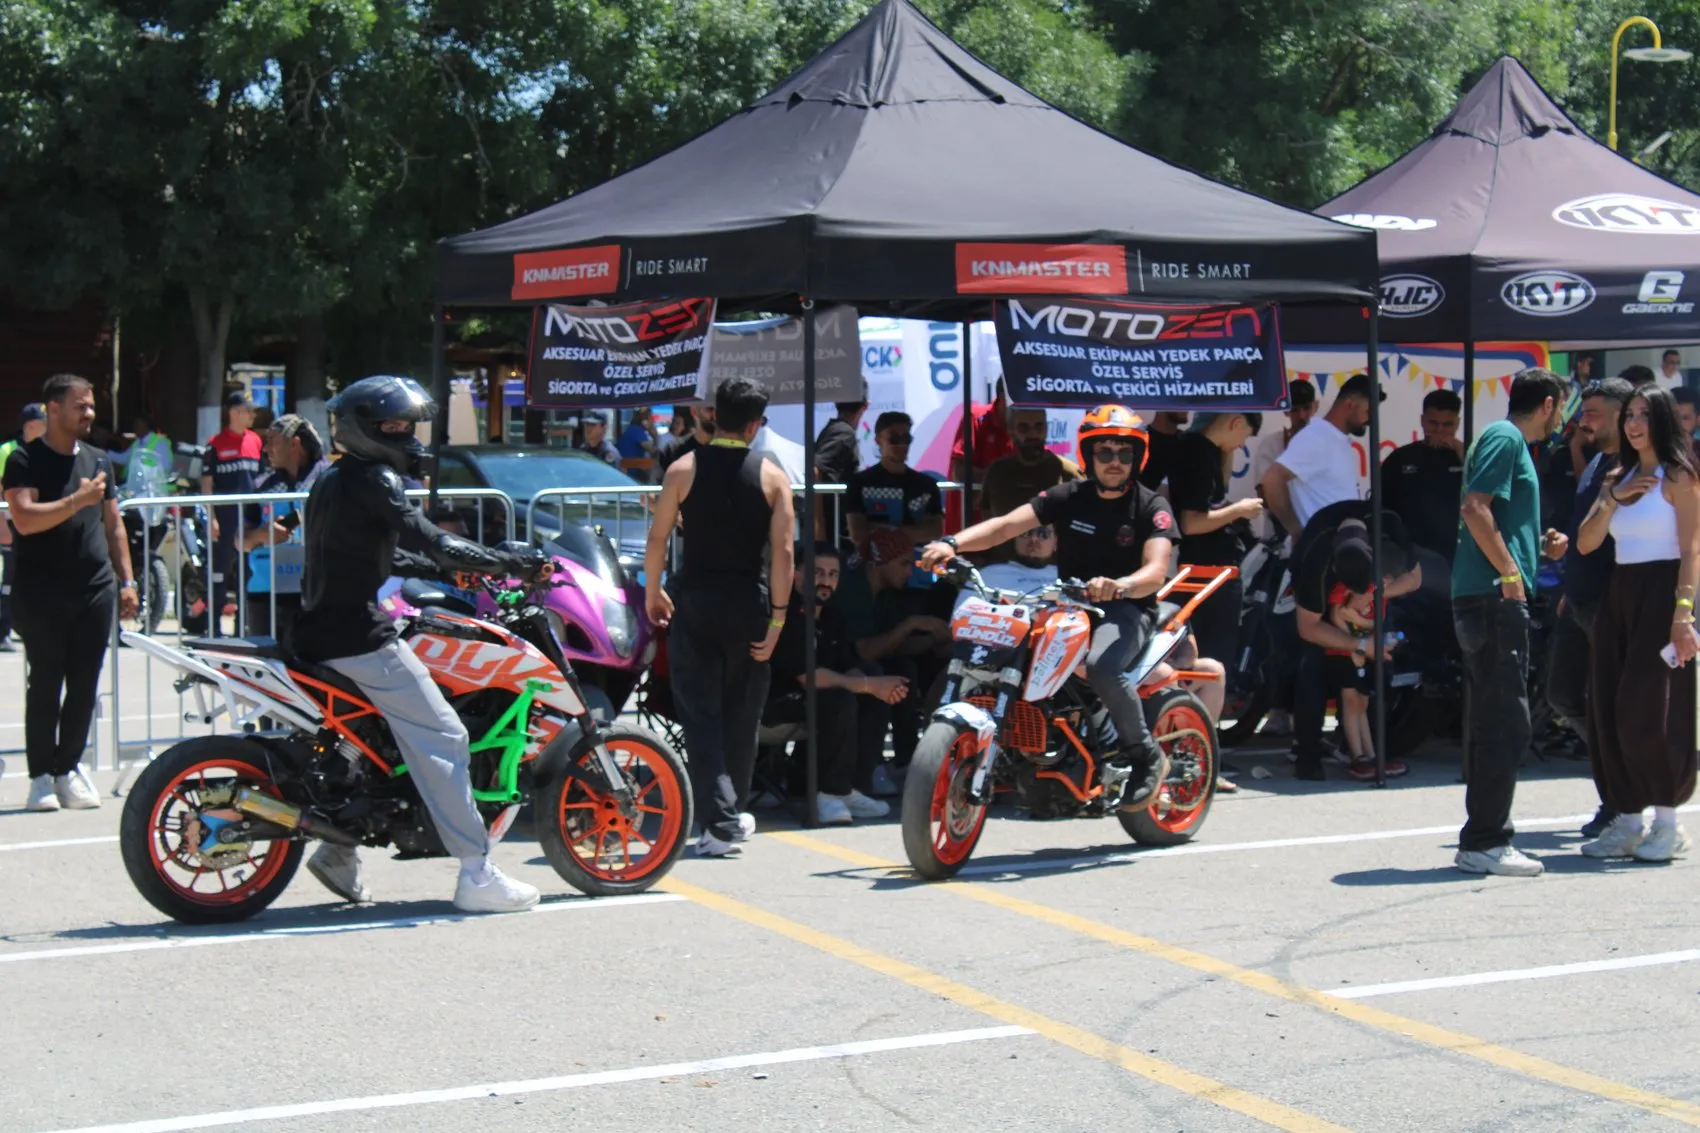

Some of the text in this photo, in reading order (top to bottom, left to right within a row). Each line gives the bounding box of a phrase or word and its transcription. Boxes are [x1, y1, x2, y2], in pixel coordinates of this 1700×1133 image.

[1562, 204, 1694, 227] KYT
[523, 257, 708, 283] KNMASTER RIDE SMART
[971, 260, 1252, 279] KNMASTER RIDE SMART
[1379, 286, 1434, 305] HJC
[1507, 281, 1582, 306] KYT
[543, 346, 604, 362] AKSESUAR
[649, 340, 683, 359] YEDEK
[1013, 341, 1263, 364] AKSESUAR EKİPMAN YEDEK PARÇA
[603, 362, 634, 379] ÖZEL
[1092, 362, 1183, 380] ÖZEL SERVİS
[548, 378, 598, 395] SİGORTA
[600, 386, 612, 396] ve
[1027, 374, 1255, 399] SİGORTA ve ÇEKİCİ HİZMETLERİ
